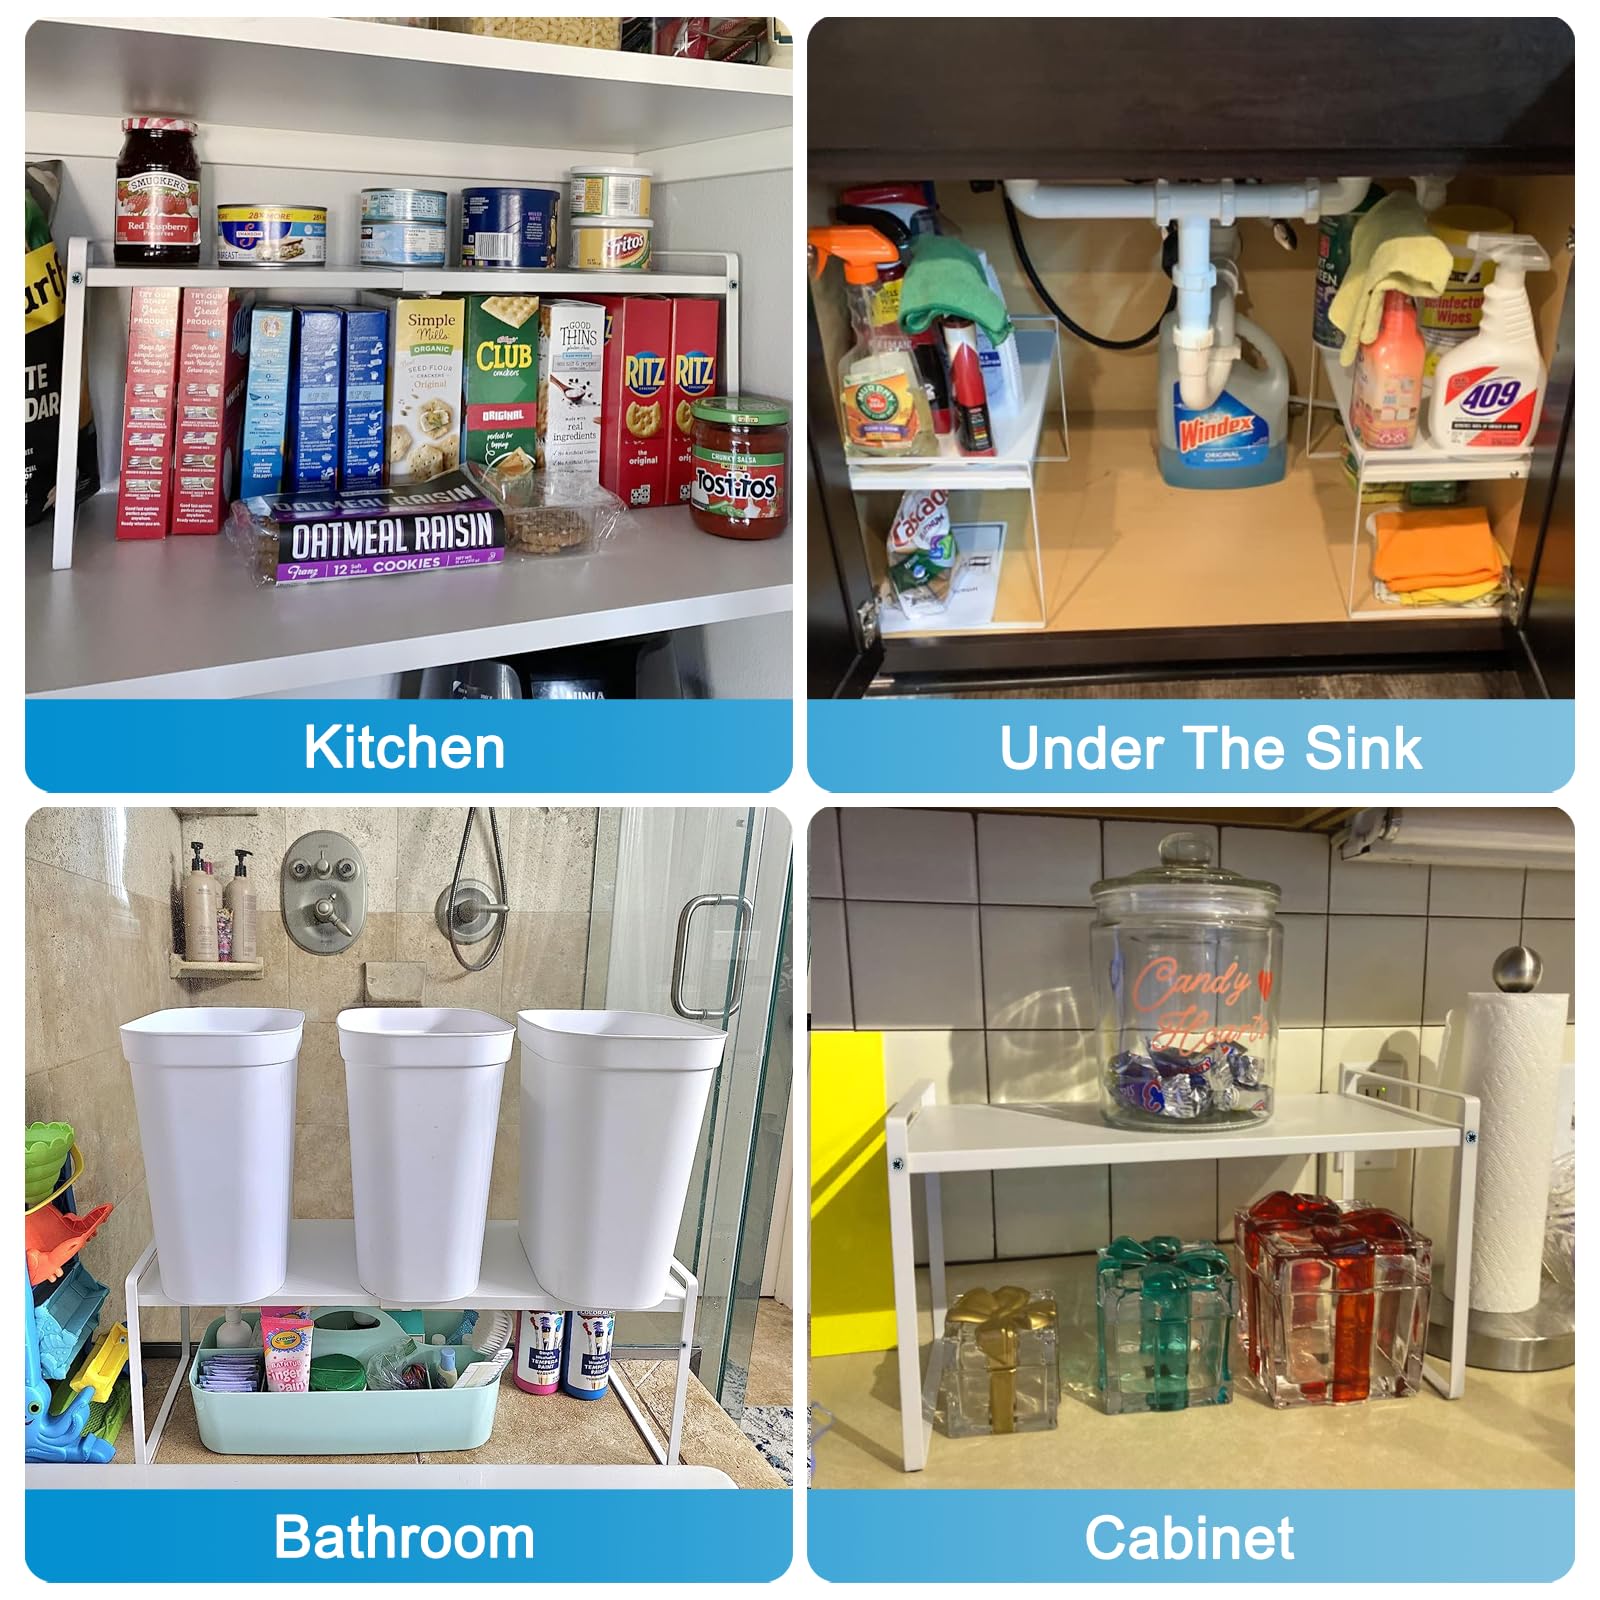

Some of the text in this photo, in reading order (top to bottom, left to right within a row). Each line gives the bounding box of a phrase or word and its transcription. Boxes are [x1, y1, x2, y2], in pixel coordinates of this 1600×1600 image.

[130, 176, 187, 192] SMUCKER'S
[128, 222, 144, 230] Red
[607, 233, 645, 258] Fritos
[194, 306, 219, 317] Great
[1438, 310, 1472, 325] Wipes
[408, 313, 456, 329] Simple
[570, 321, 591, 329] GOOD
[416, 328, 449, 341] Mills
[560, 326, 597, 345] THINS
[414, 345, 450, 353] ORGANIC
[476, 341, 533, 371] CLUB
[408, 365, 426, 373] SEED
[493, 369, 520, 377] crackers
[625, 355, 666, 387] RITZ
[675, 354, 714, 386] RITZ
[414, 381, 447, 389] Original
[857, 384, 896, 401] MURPHY
[1463, 381, 1521, 409] 409
[482, 409, 525, 422] ORIGINAL
[568, 421, 583, 430] real
[553, 432, 597, 442] ingredients
[1180, 416, 1255, 453] Windex
[629, 456, 658, 465] original
[711, 452, 757, 464] CHUNKY SALSA
[273, 498, 388, 512] OATMEAL
[392, 484, 477, 506] RAISIN
[292, 512, 493, 560] OATMEAL RAISIN
[333, 564, 348, 576] 12
[373, 557, 441, 572] COOKIES
[288, 565, 318, 580] Franz
[1132, 956, 1252, 1013] Candy
[274, 1335, 298, 1343] Crayola
